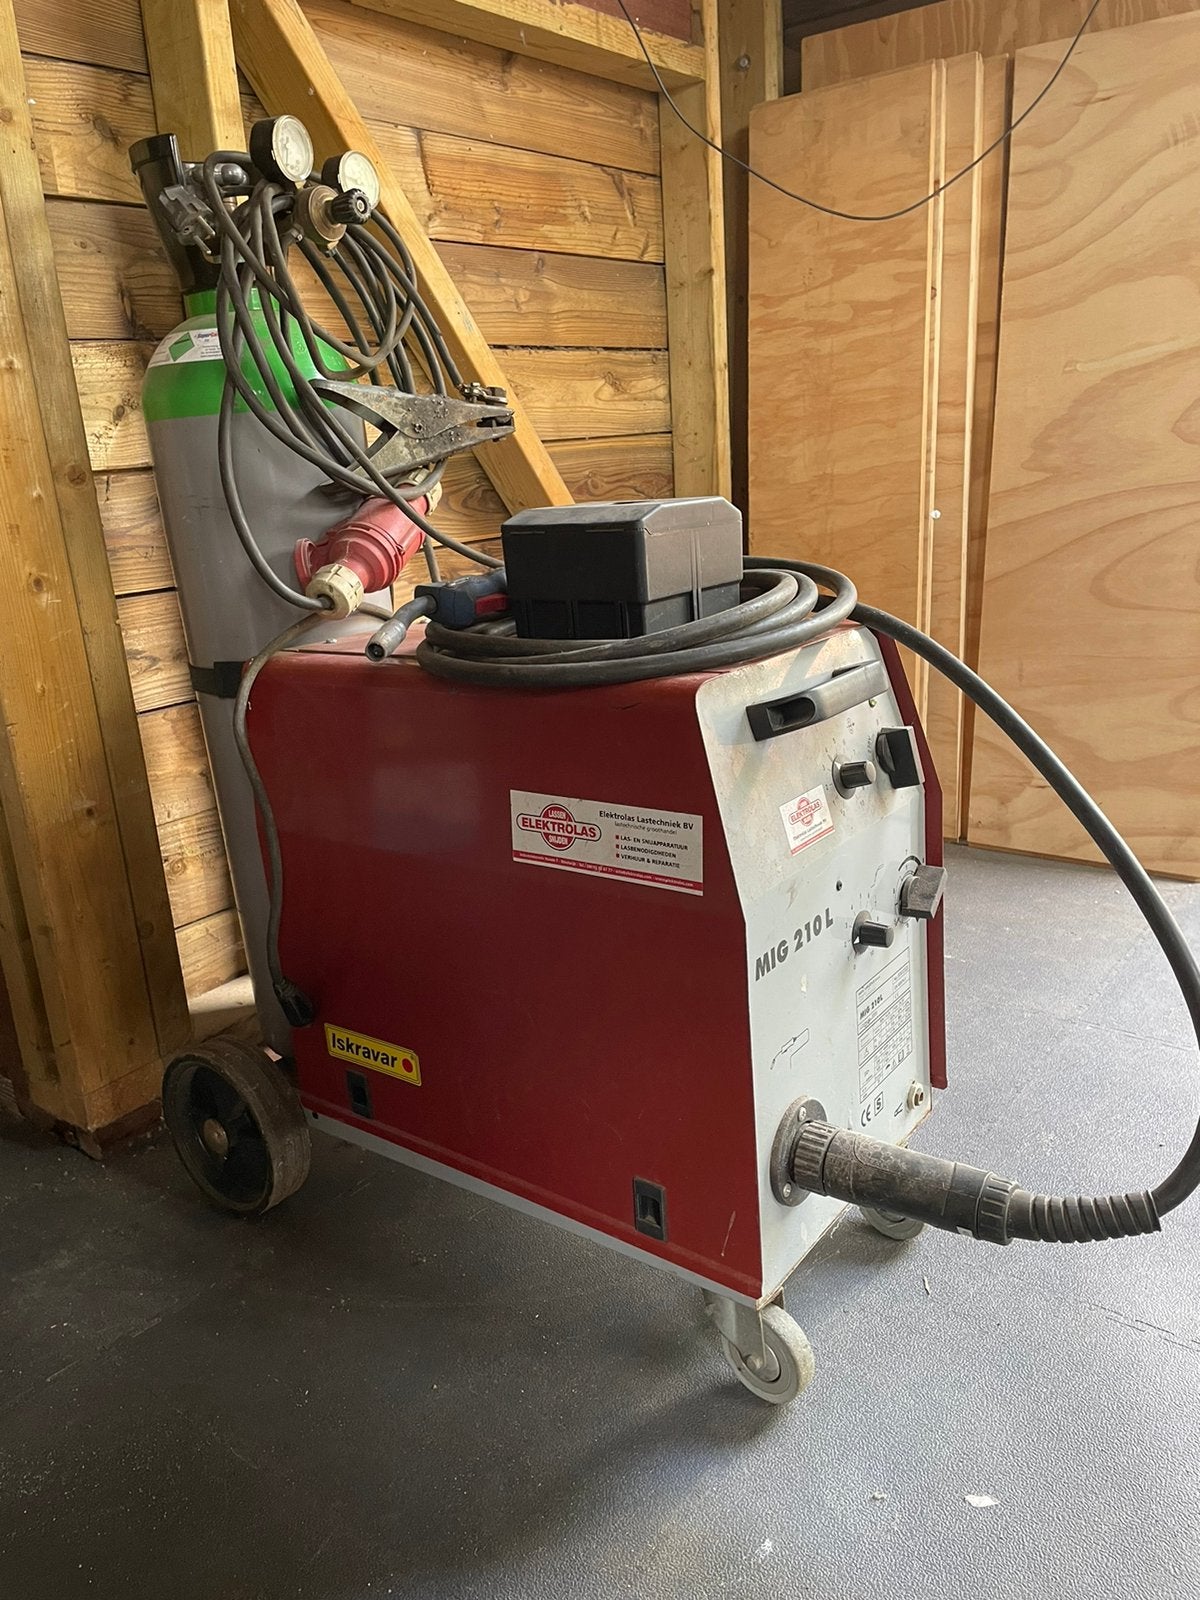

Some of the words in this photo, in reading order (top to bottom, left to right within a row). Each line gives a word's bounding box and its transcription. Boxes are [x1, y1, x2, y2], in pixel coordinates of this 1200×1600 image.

[599, 810, 635, 822] Elektrolas
[636, 815, 682, 829] Lastechniek
[683, 822, 694, 830] BV
[790, 801, 820, 822] ELEKTROLAS
[521, 816, 597, 838] ELEKTROLAS
[621, 853, 646, 863] VERHUUR
[651, 859, 680, 868] REPARATIE
[755, 939, 789, 982] MIG
[331, 1032, 398, 1068] Iskravar
